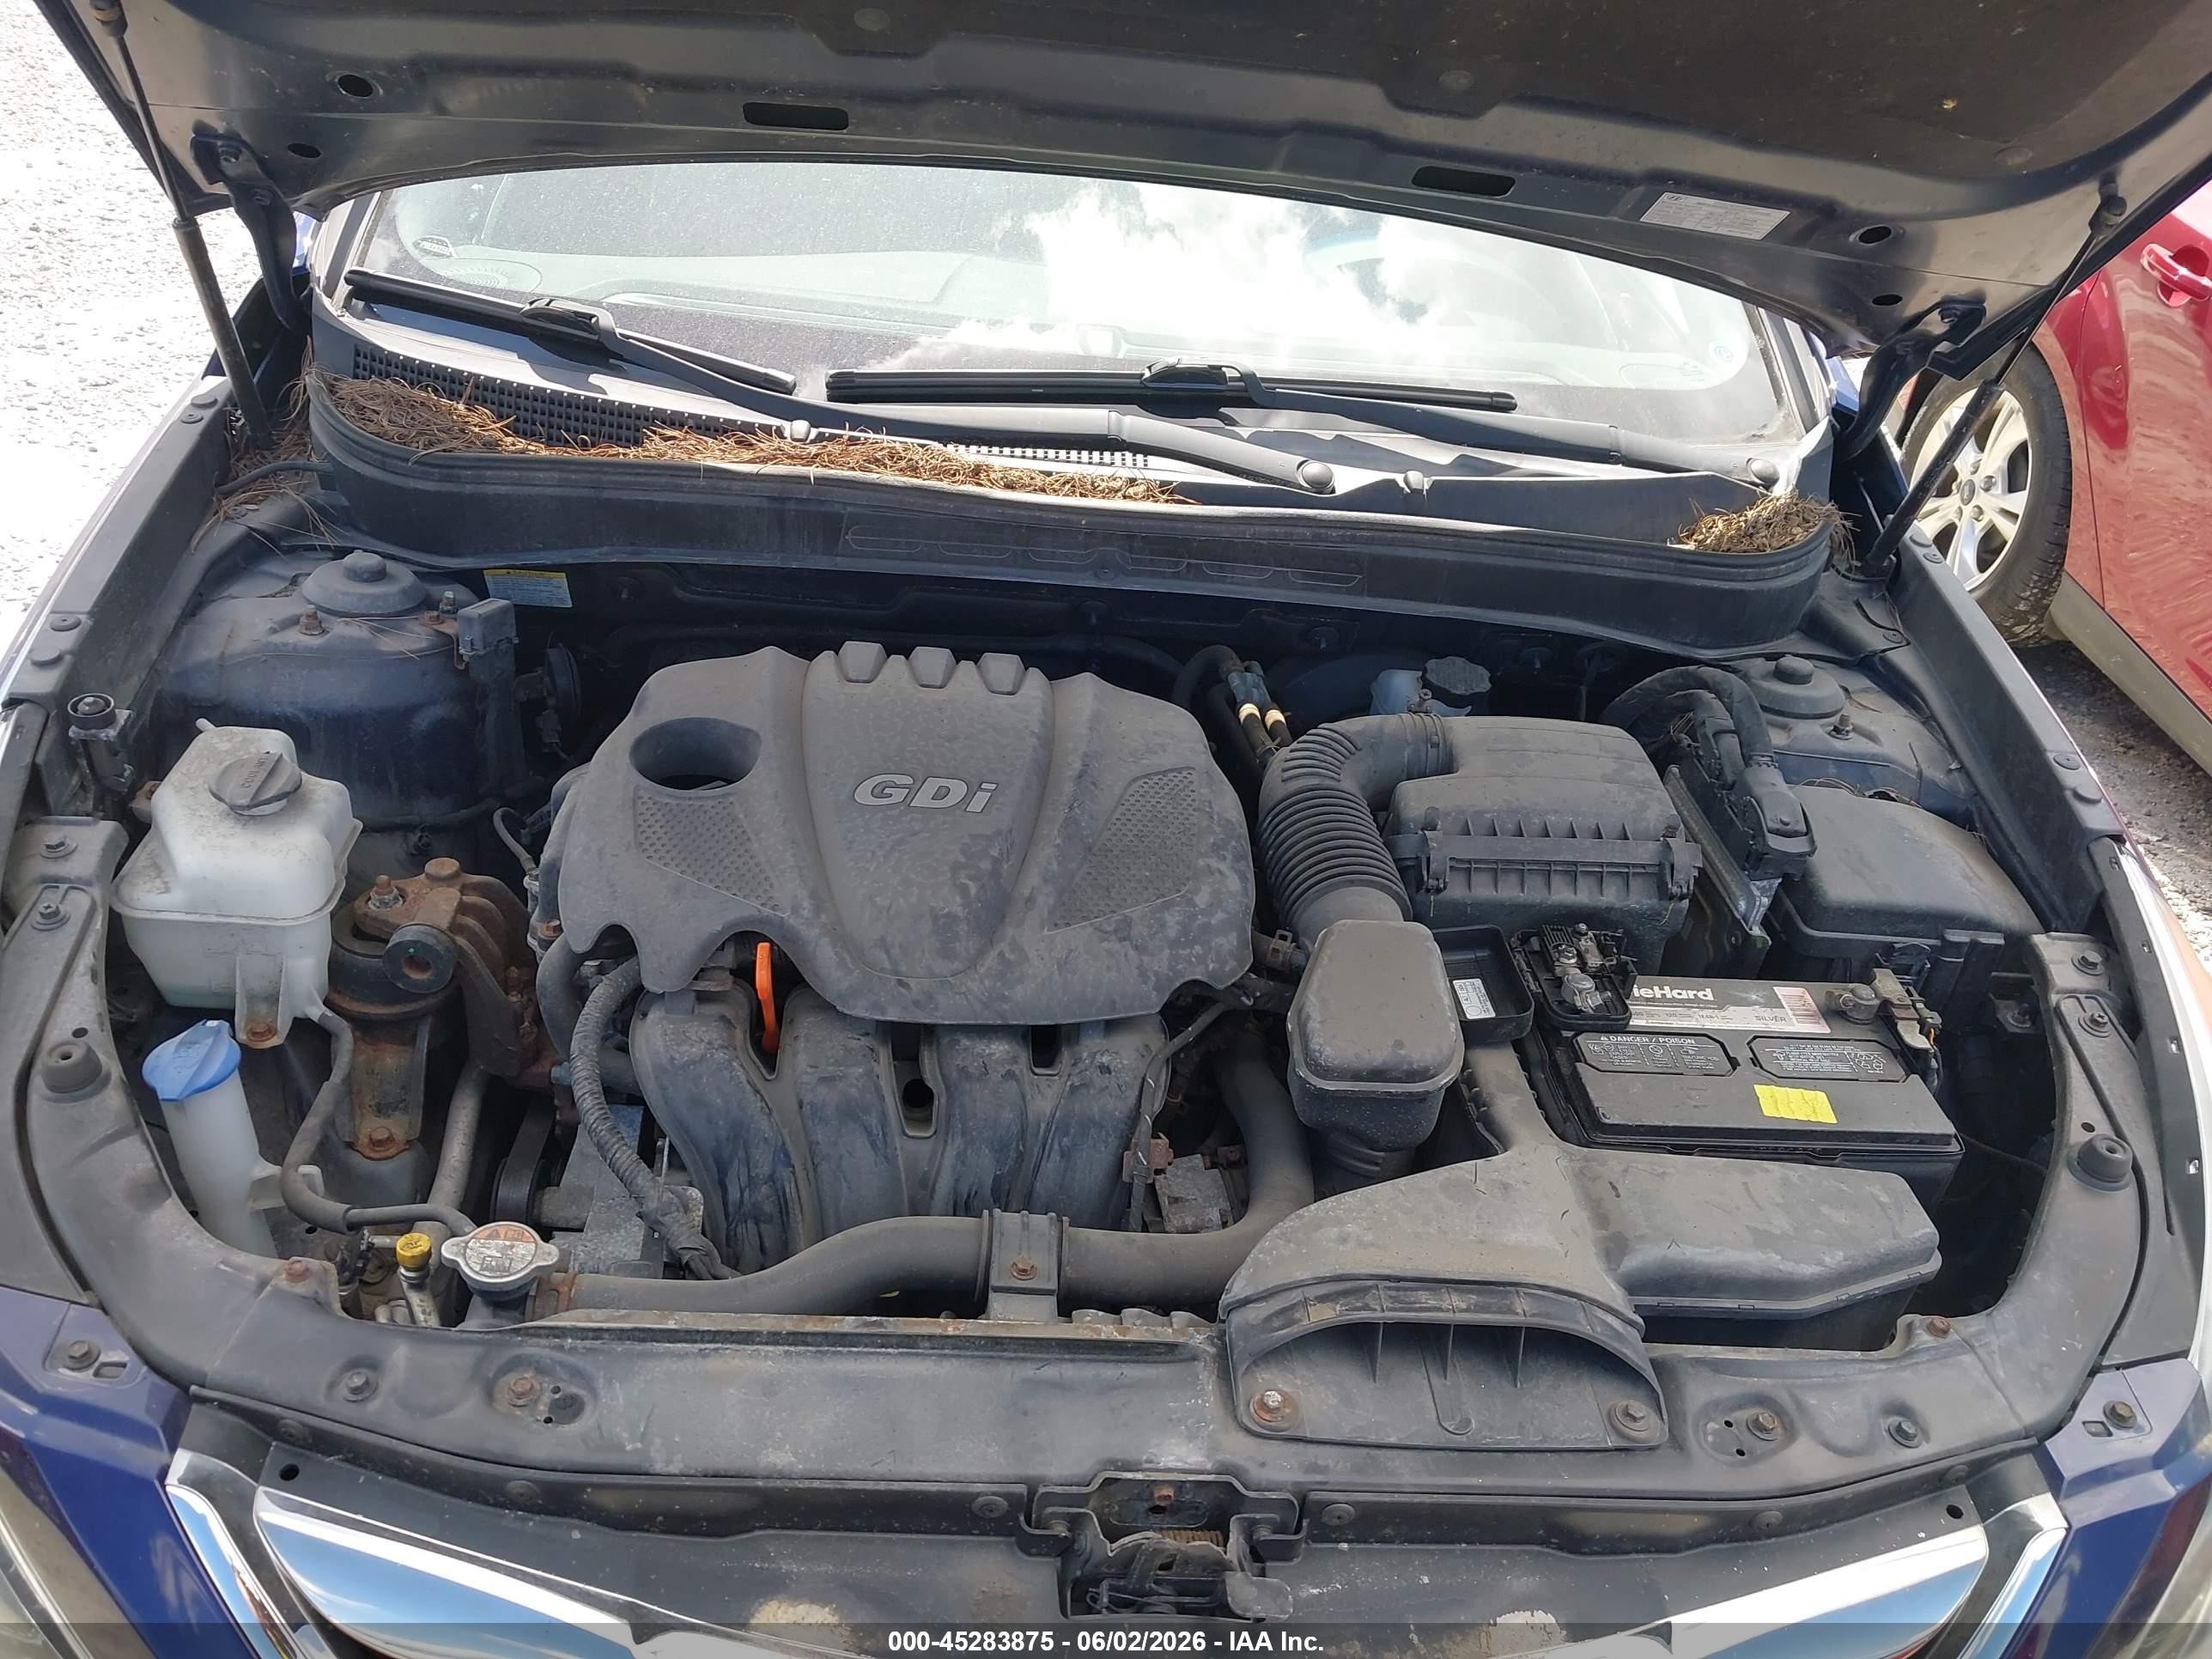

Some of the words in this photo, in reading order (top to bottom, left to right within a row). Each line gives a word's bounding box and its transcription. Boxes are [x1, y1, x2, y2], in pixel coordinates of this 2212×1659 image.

[854, 773, 1000, 814] GDi
[1632, 984, 1715, 1001] ieHard
[1754, 1014, 1787, 1023] SILVER
